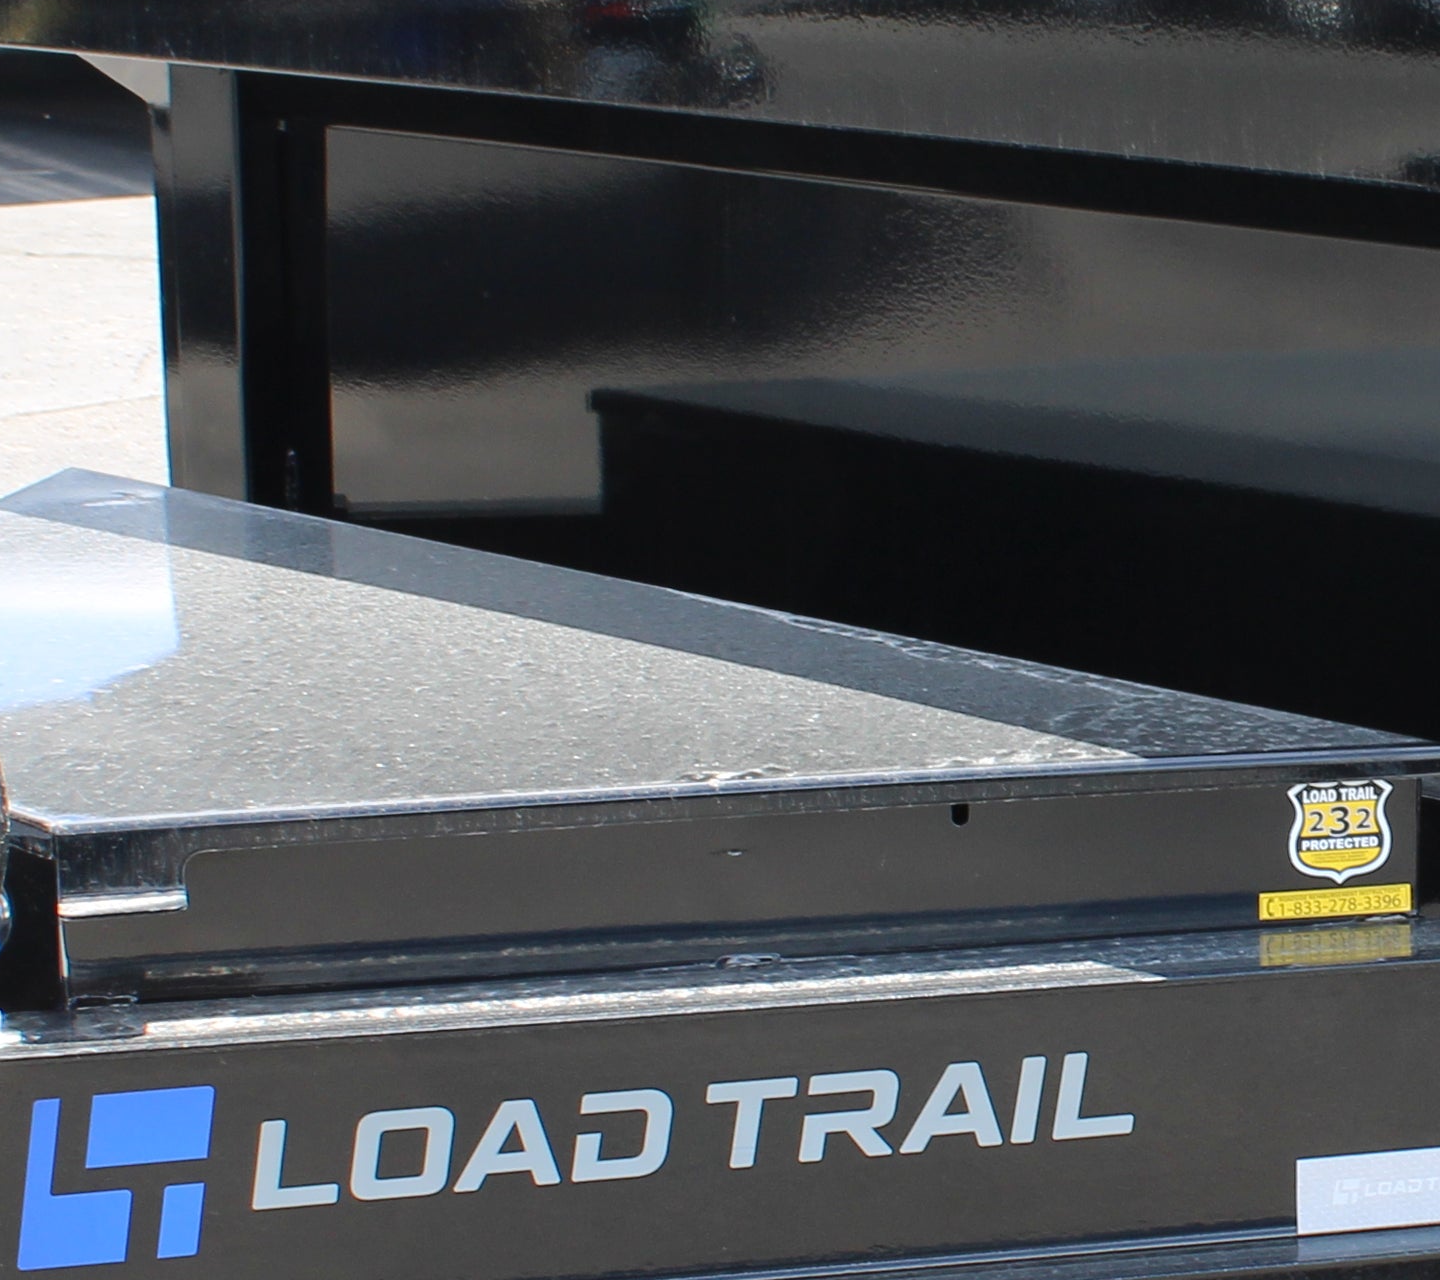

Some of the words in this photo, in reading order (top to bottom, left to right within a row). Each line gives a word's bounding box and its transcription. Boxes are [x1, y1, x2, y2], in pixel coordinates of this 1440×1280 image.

[1302, 788, 1337, 804] LOAD
[1339, 786, 1378, 802] TRAIL
[1309, 806, 1371, 835] 232
[1301, 836, 1379, 852] PROTECTED
[1279, 894, 1402, 916] 1-833-278-3396
[251, 1086, 674, 1211] LOAD
[706, 1051, 1135, 1169] TRAIL
[1364, 1178, 1423, 1198] LOAD
